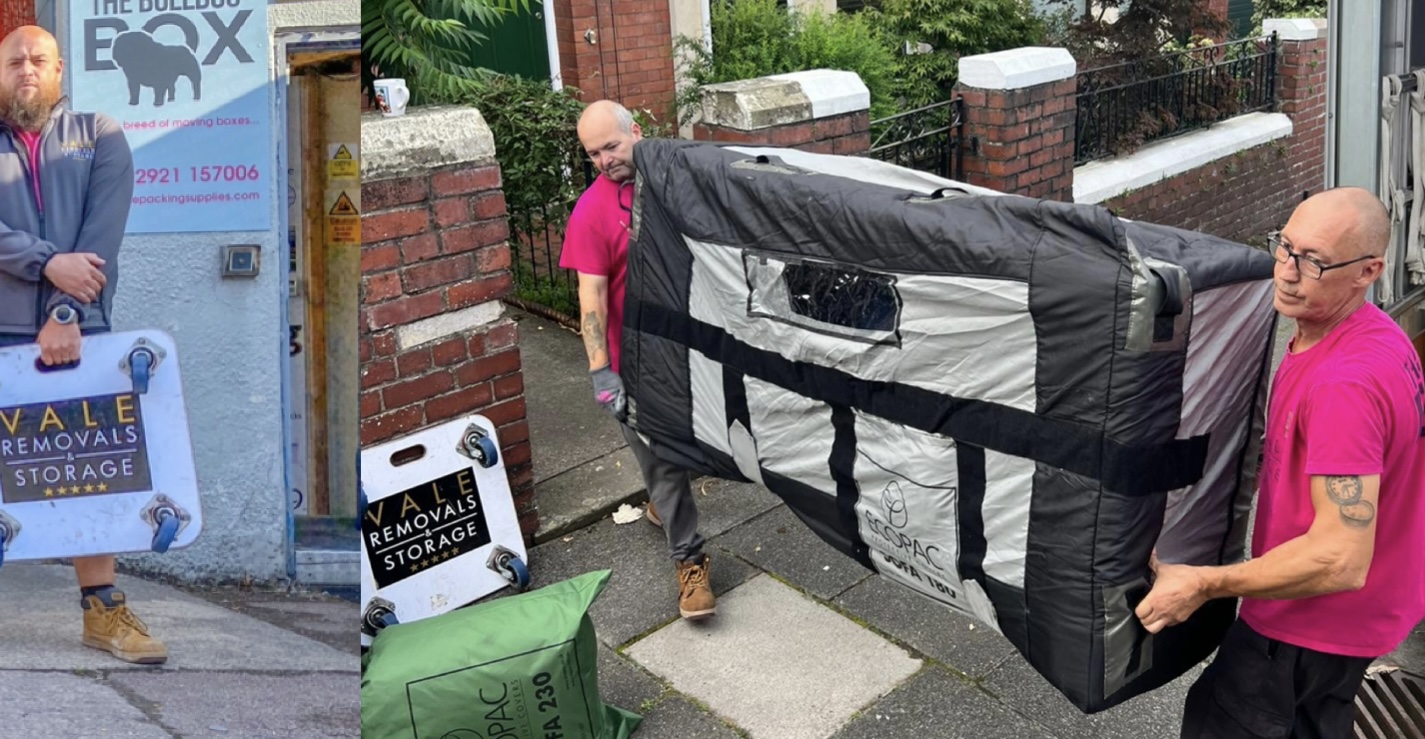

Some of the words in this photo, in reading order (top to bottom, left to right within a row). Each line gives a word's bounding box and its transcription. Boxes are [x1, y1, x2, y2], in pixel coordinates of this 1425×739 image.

[84, 10, 255, 71] BOX
[173, 117, 213, 128] moving
[190, 164, 260, 182] 157006
[1, 425, 138, 457] REMOVALS
[67, 452, 75, 461] &
[14, 458, 134, 487] STORAGE
[367, 471, 473, 527] VALE
[369, 495, 477, 547] REMOVALS
[425, 529, 433, 537] &
[384, 521, 477, 571] STORAGE
[865, 509, 945, 571] ECOPAC
[532, 672, 558, 713] 230
